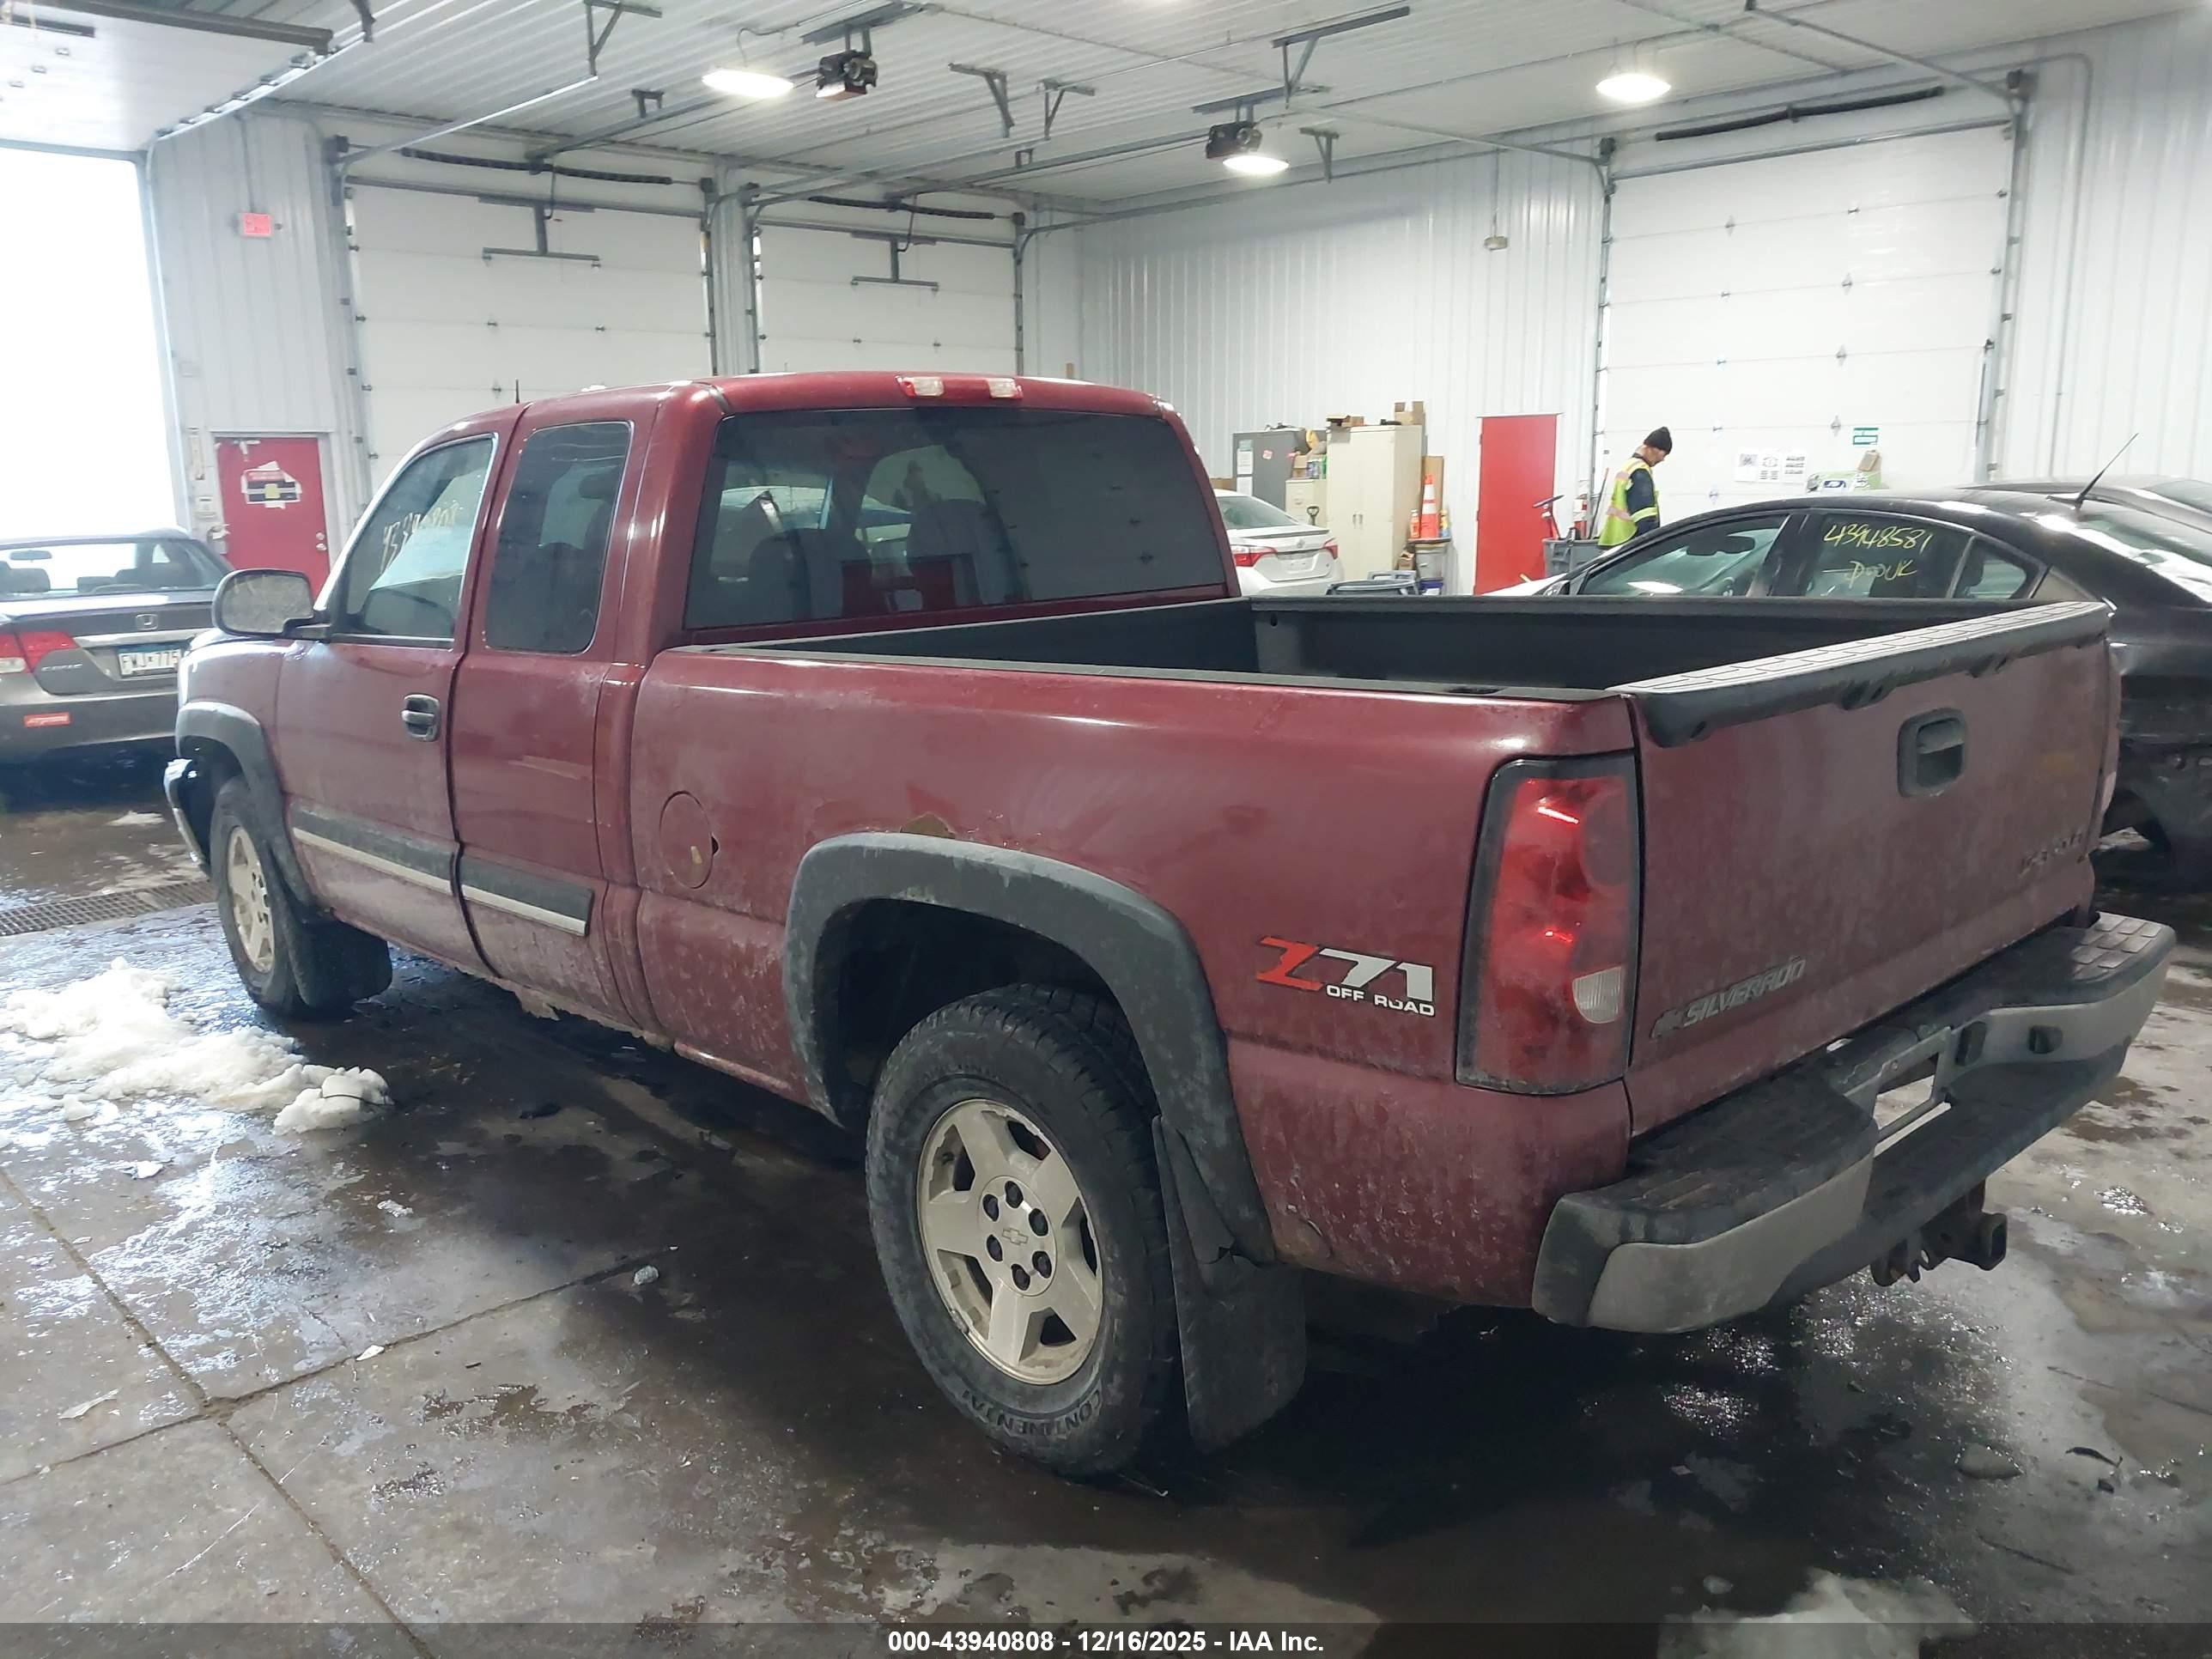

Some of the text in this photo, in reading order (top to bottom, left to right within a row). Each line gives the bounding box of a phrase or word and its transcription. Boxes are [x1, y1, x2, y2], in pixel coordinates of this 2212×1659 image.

[1823, 523, 1933, 556] 43948581
[1255, 936, 1433, 1003] Z71
[1683, 958, 1806, 1027] SILVERADO
[1326, 984, 1436, 1017] OFF ROAD
